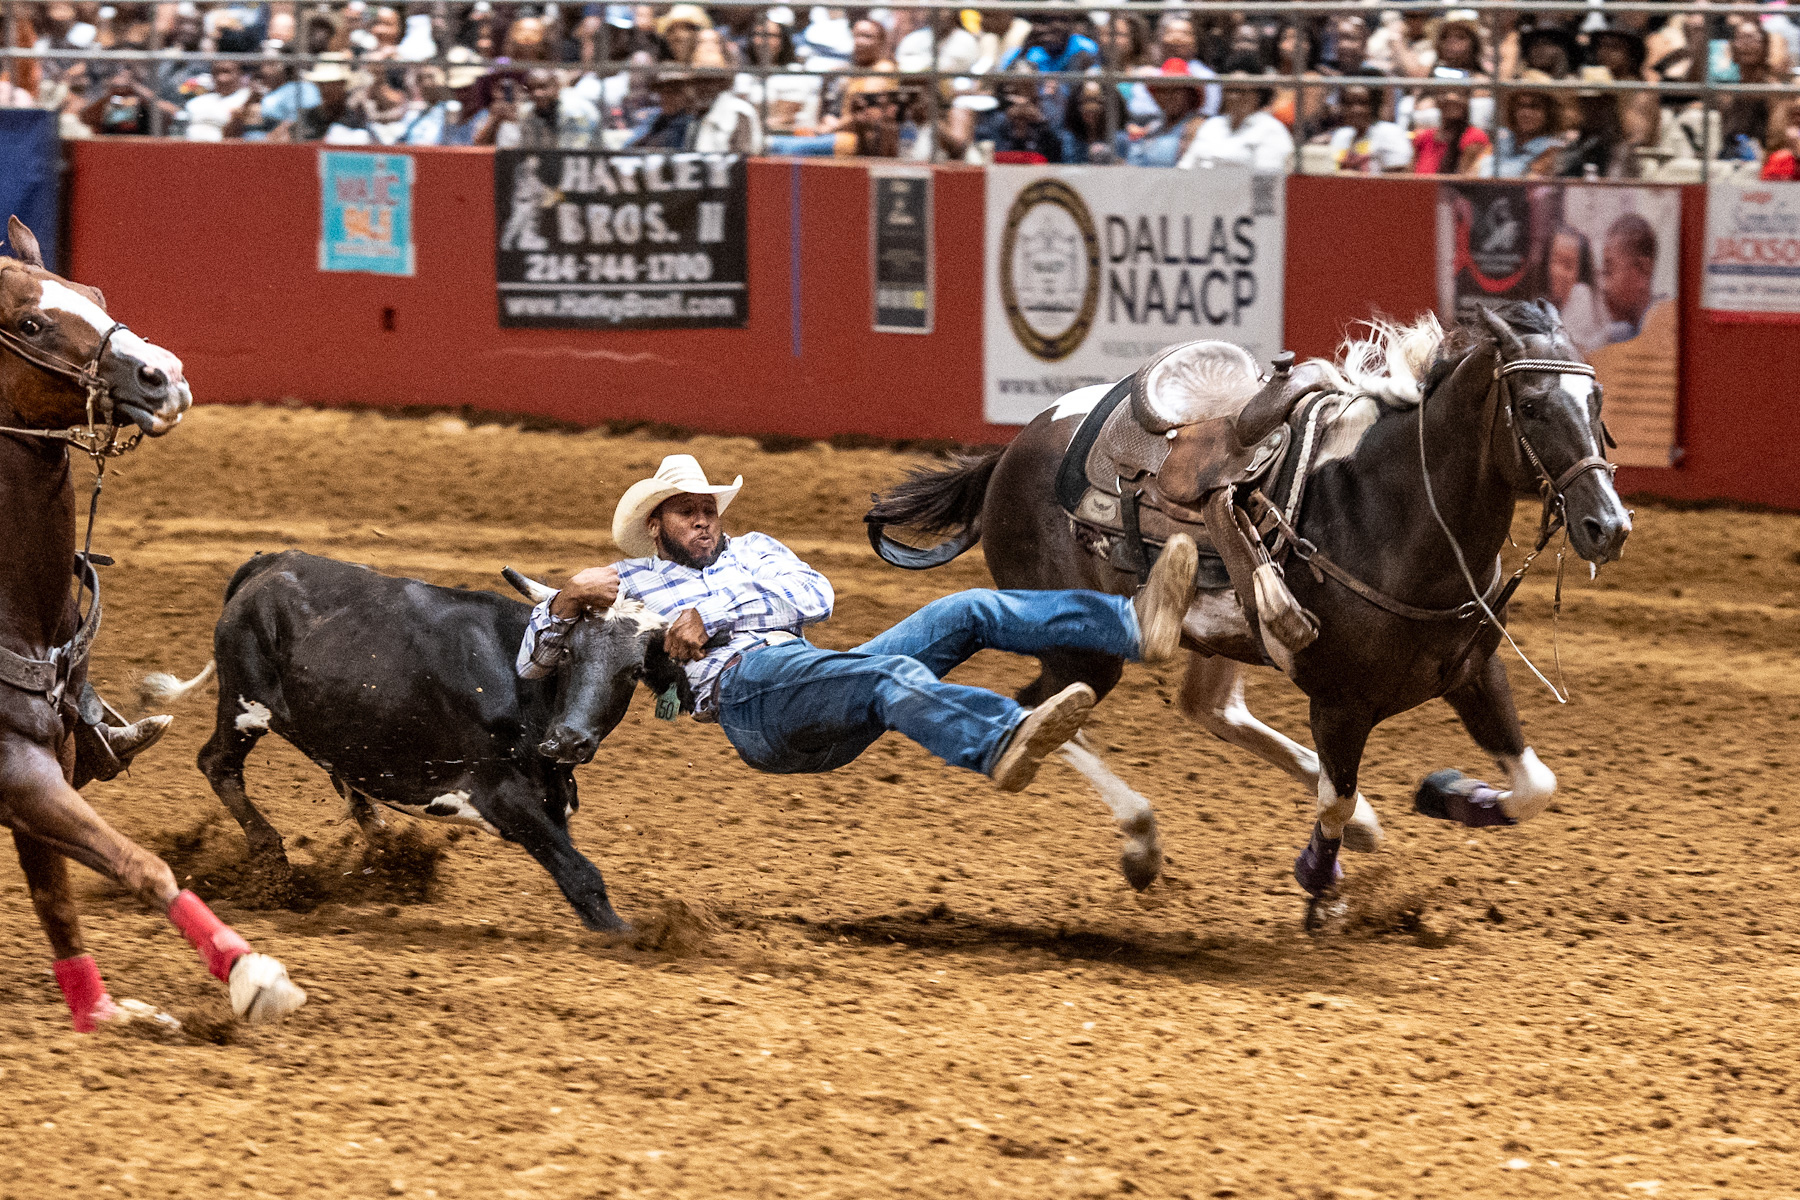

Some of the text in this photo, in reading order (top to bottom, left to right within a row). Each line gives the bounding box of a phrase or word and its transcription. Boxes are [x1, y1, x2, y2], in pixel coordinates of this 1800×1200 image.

[560, 154, 739, 194] HATLEY
[557, 202, 680, 244] BROS.
[1105, 215, 1256, 266] DALLAS
[1107, 270, 1258, 325] NAACP
